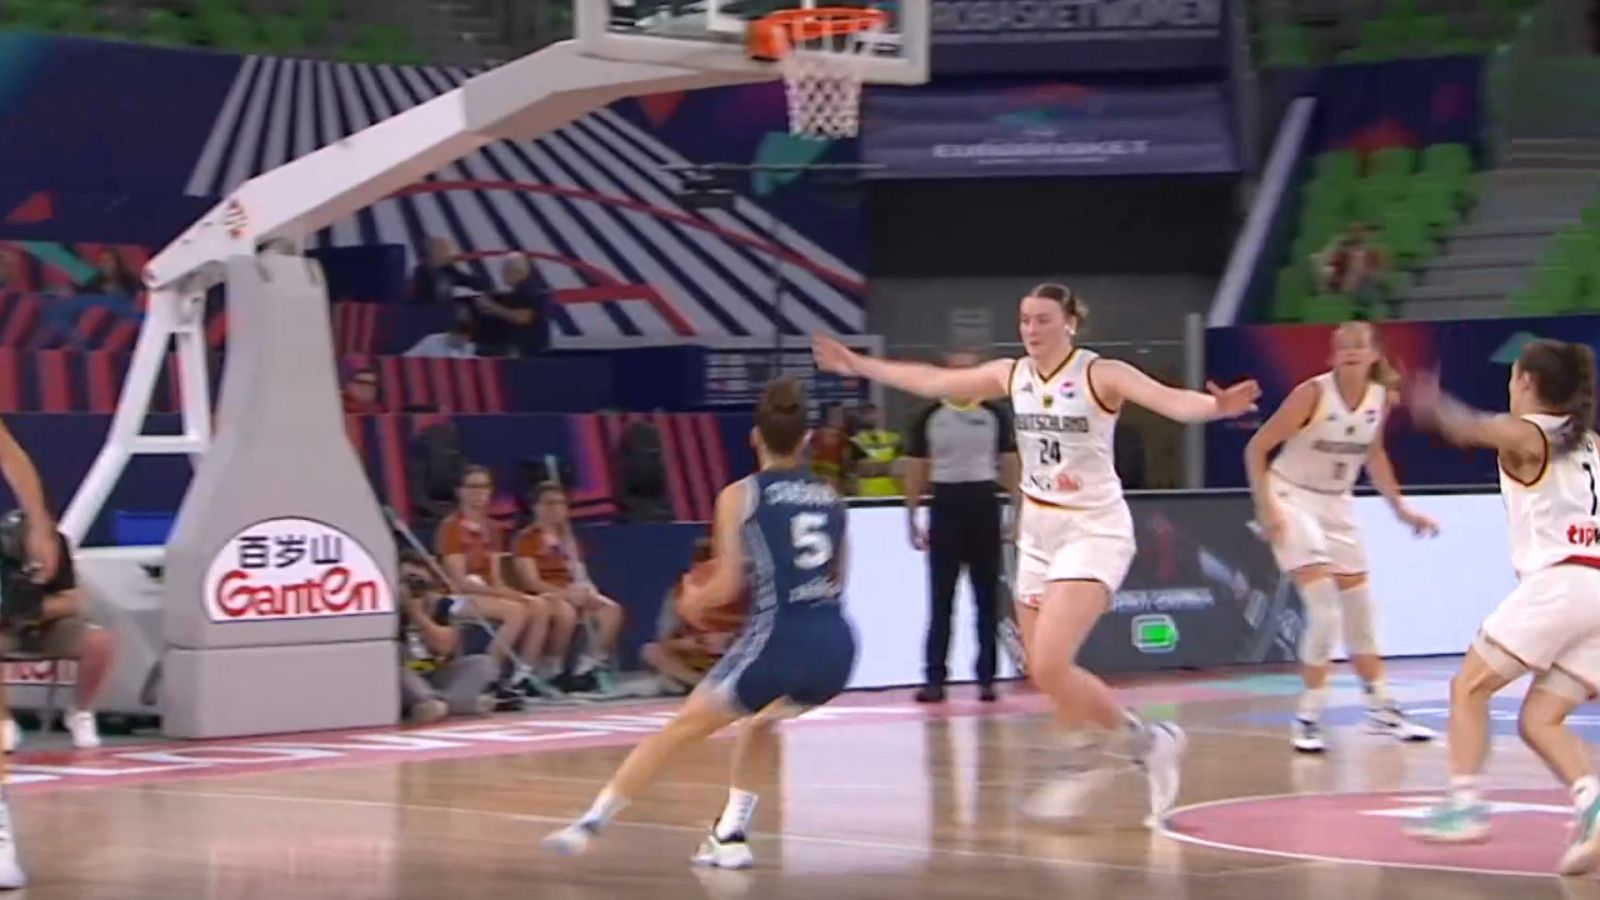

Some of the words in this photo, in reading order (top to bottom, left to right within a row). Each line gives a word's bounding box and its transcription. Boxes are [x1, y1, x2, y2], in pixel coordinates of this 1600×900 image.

[1014, 413, 1089, 433] EUTSCHLAND
[1038, 438, 1062, 465] 24
[238, 534, 342, 568] 百岁山
[789, 511, 834, 570] 5
